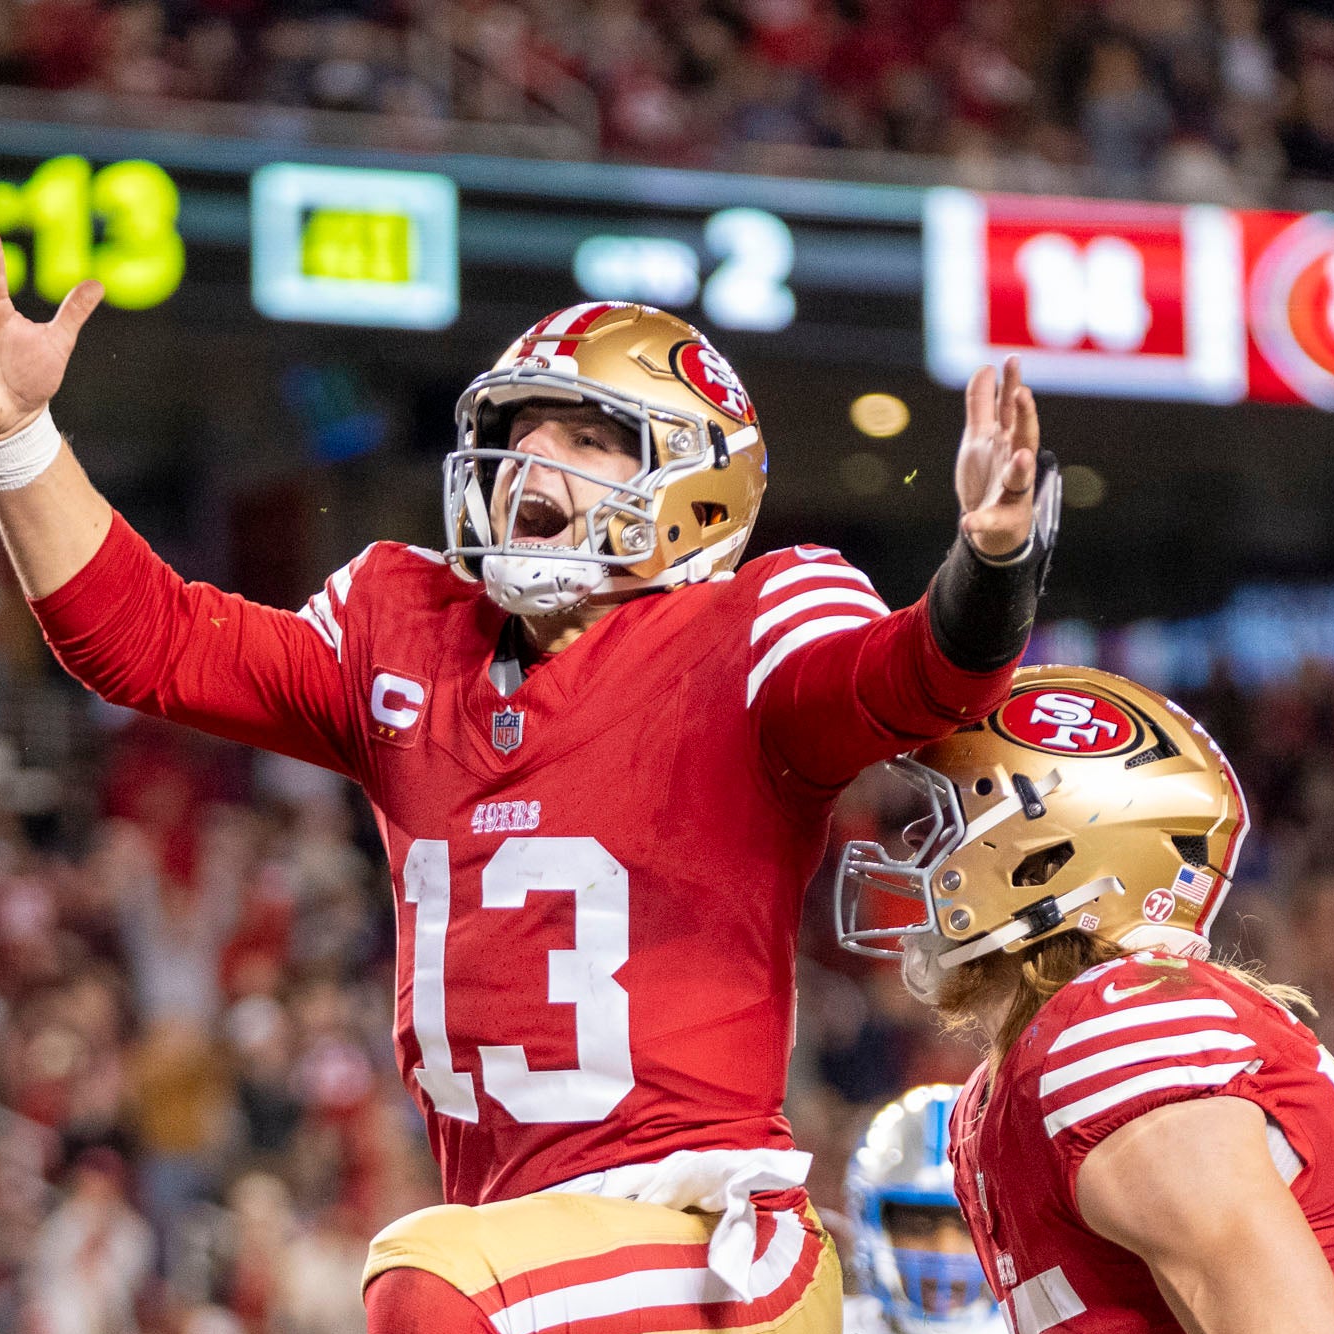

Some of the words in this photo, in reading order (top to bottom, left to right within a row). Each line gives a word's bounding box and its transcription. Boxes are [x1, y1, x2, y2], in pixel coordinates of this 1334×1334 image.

[702, 206, 796, 333] 2
[370, 672, 425, 730] C
[1029, 692, 1118, 750] SF
[496, 727, 518, 746] NFL
[470, 800, 542, 834] 49ERS
[1145, 893, 1174, 921] 37
[403, 836, 636, 1124] 13
